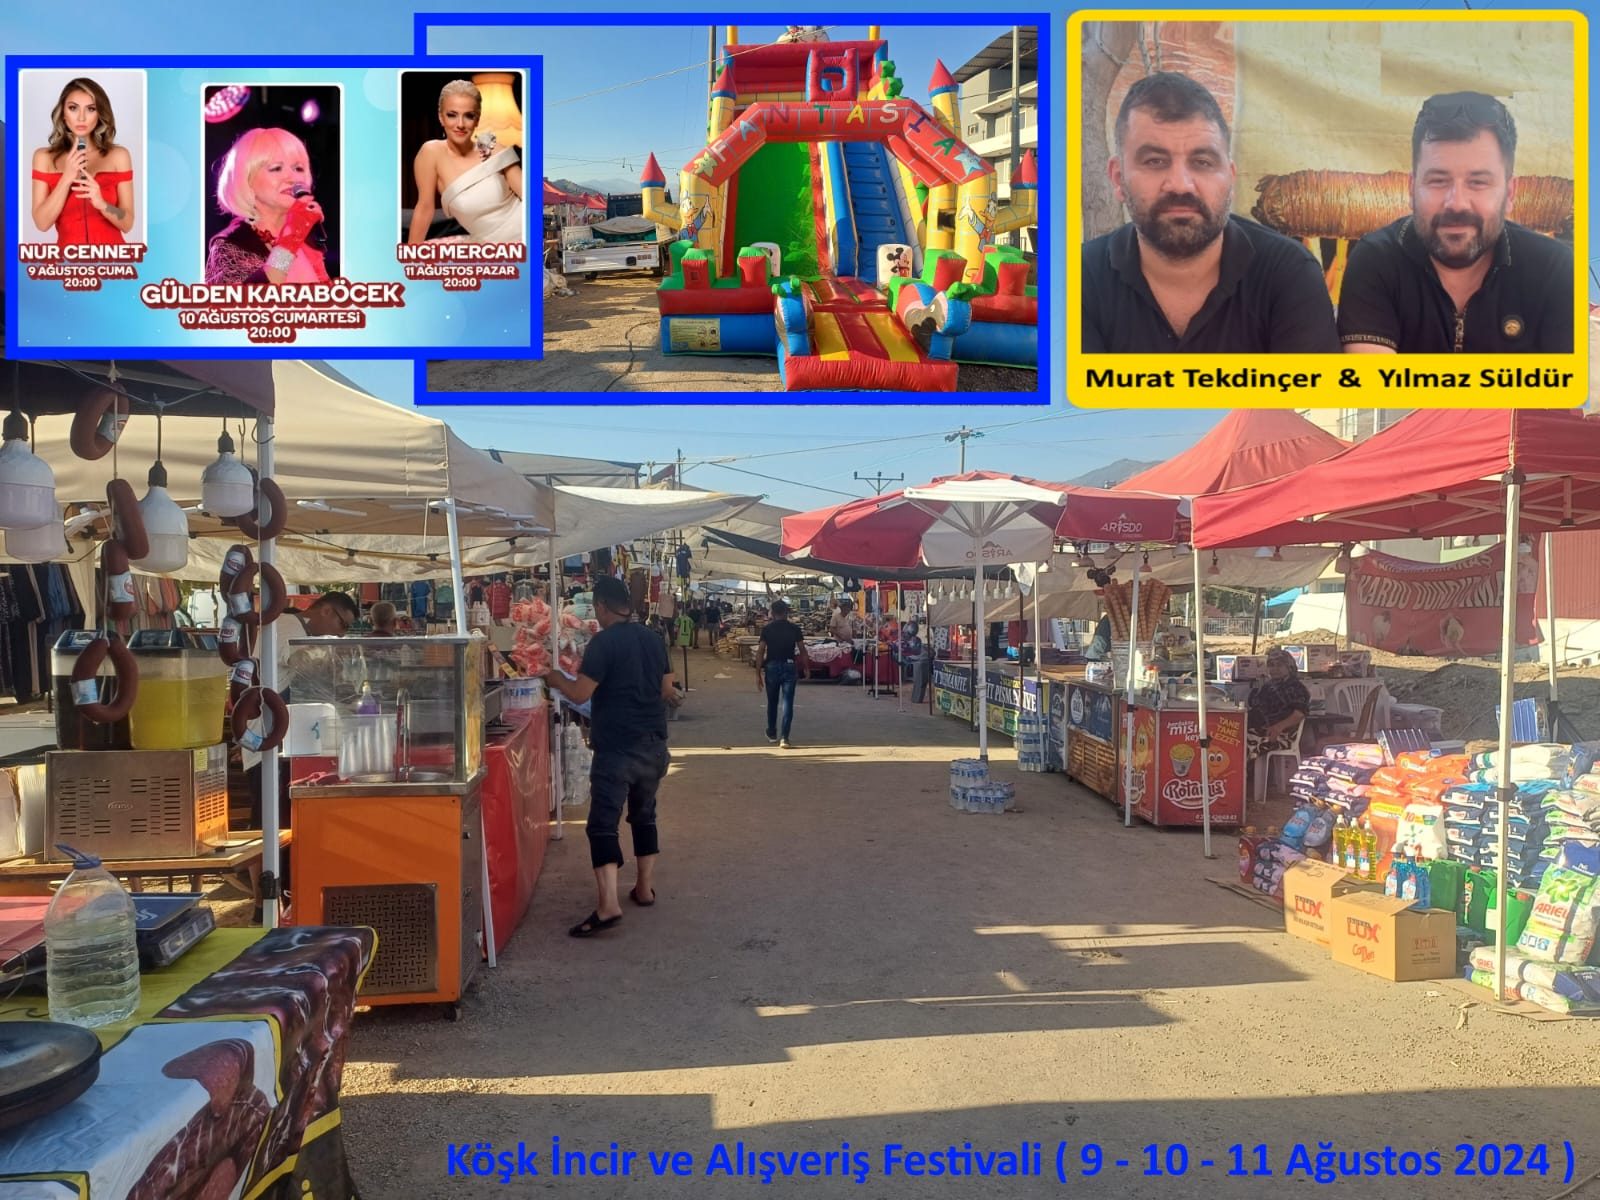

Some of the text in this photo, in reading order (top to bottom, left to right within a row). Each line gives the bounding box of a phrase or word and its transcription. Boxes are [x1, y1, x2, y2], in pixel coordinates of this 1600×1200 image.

[713, 102, 954, 163] FANTASIA
[1219, 716, 1241, 730] TANE
[1216, 724, 1240, 738] TANE
[1535, 903, 1570, 920] ARIEL
